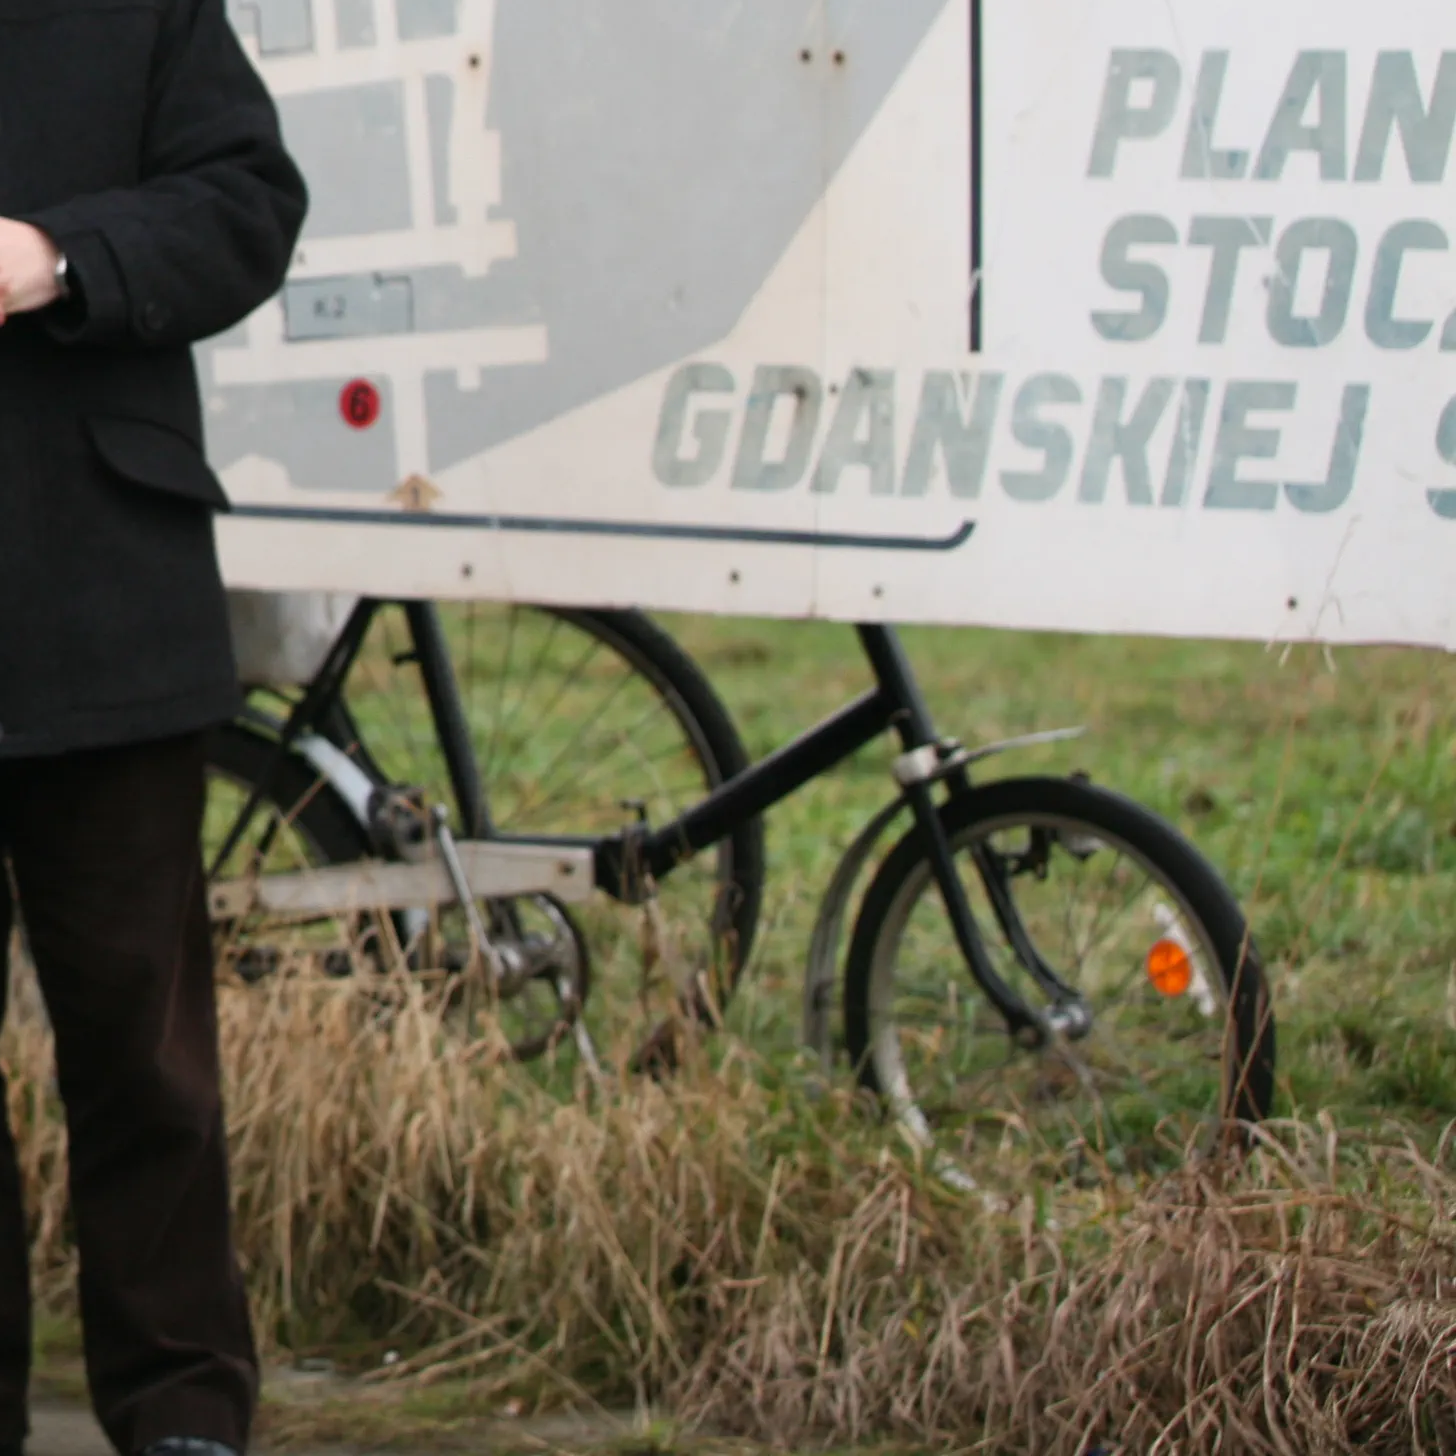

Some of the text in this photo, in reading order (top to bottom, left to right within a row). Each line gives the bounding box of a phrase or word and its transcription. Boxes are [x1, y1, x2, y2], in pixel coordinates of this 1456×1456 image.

[1086, 47, 1456, 184] PLAN
[1088, 211, 1456, 354] STOC
[349, 385, 370, 423] 6
